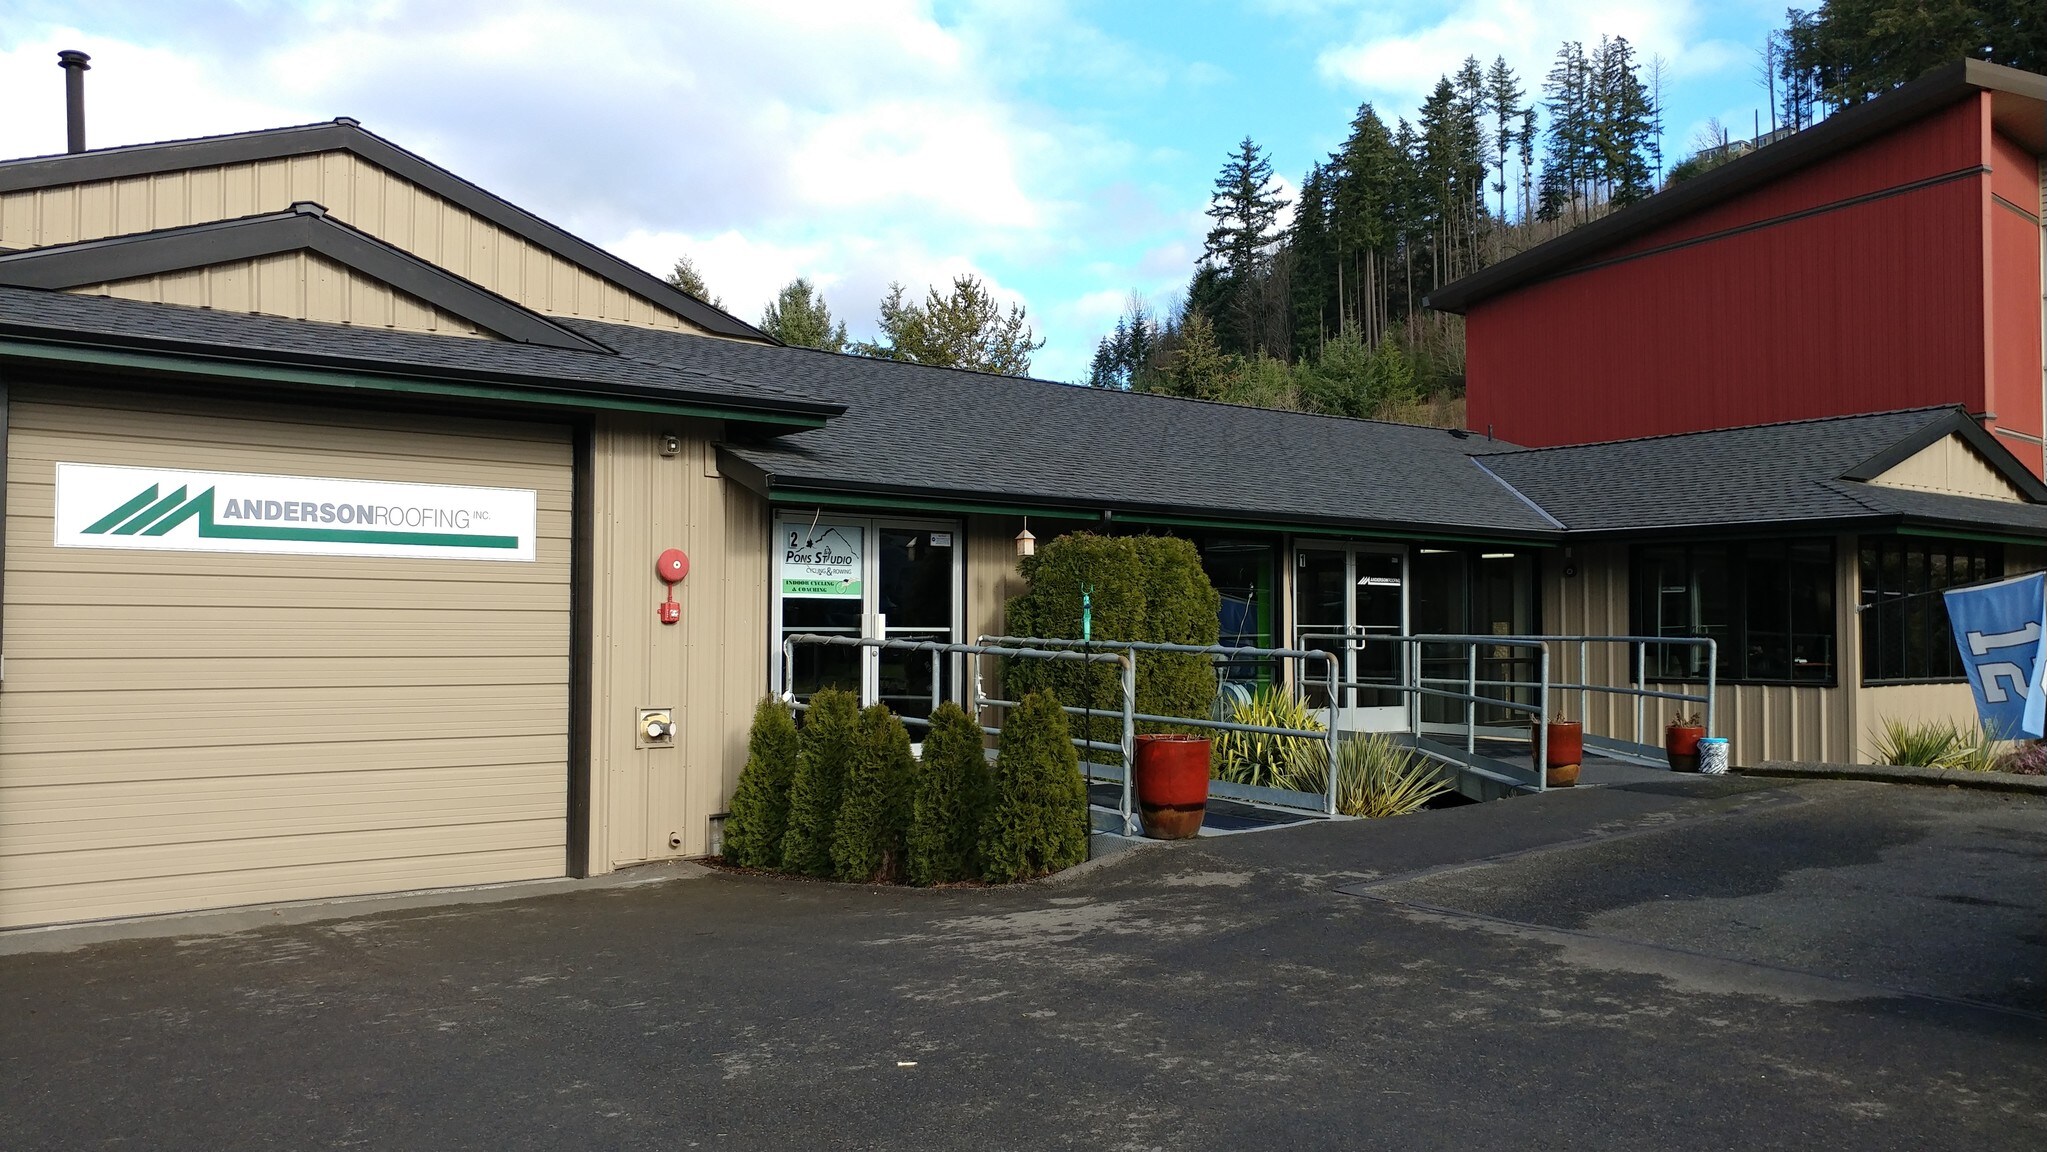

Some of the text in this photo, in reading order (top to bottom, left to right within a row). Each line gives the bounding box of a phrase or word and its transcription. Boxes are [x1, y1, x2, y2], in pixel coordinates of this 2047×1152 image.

[473, 510, 491, 520] INC.
[790, 532, 798, 547] 2
[1966, 621, 2042, 704] 12
